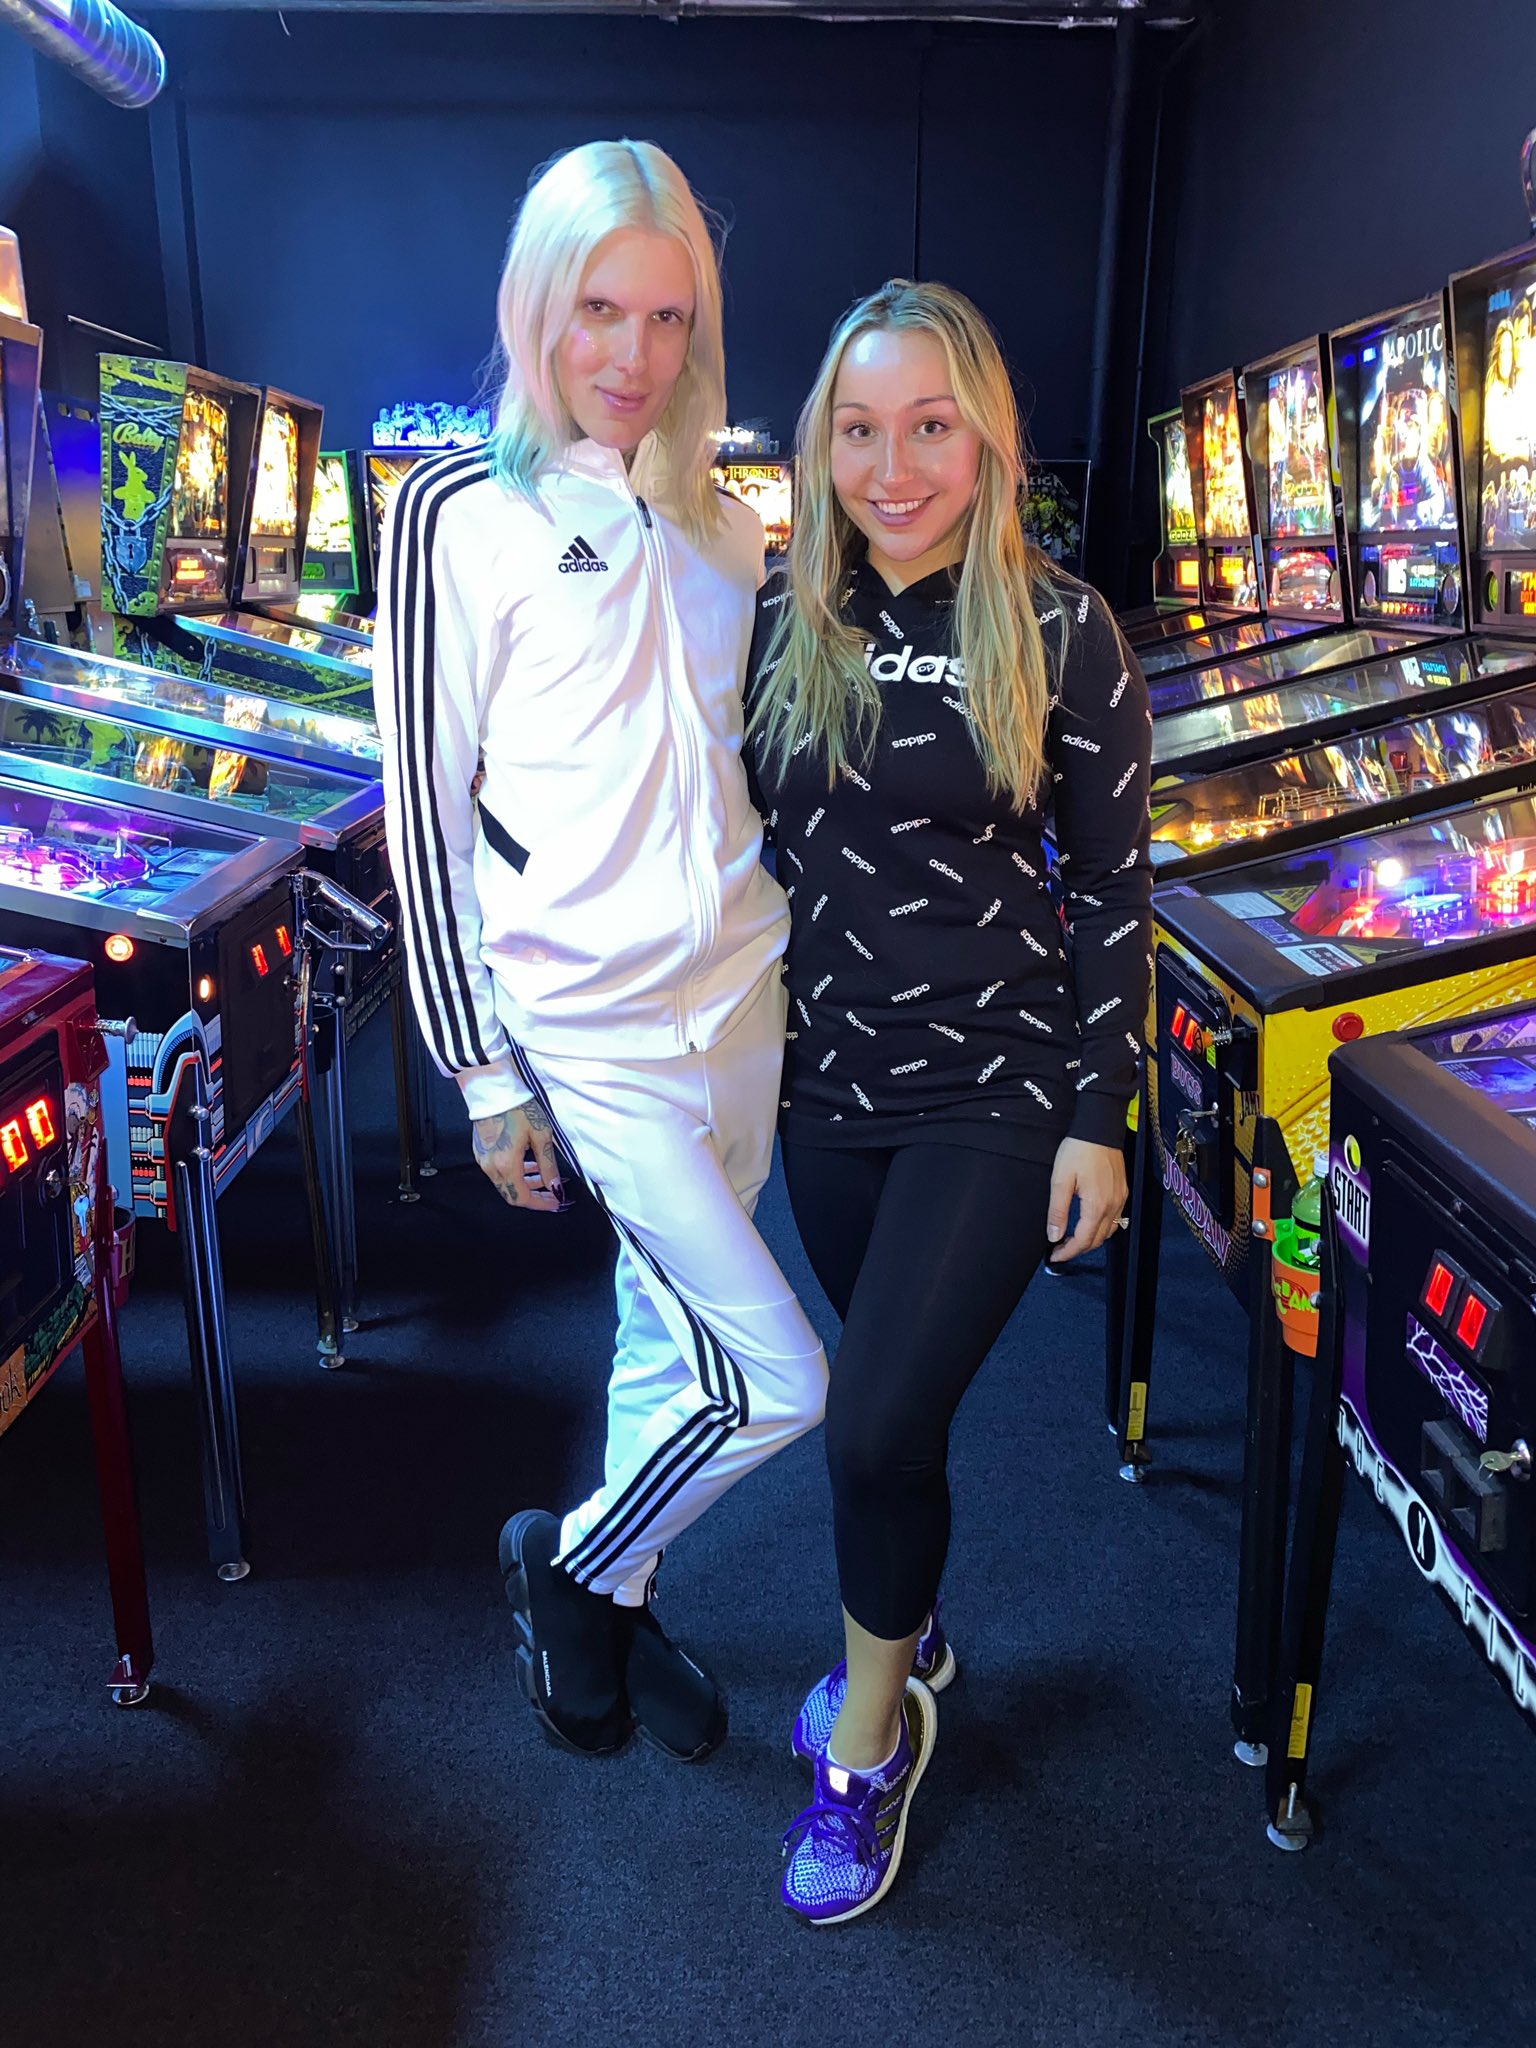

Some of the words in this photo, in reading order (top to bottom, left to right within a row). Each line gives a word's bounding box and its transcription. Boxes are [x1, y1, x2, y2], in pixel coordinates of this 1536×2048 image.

[727, 465, 780, 480] THRONES
[558, 558, 609, 574] adidas
[1078, 594, 1089, 623] adidas
[879, 610, 905, 639] adidas
[1110, 671, 1129, 707] adidas
[892, 732, 936, 749] adidas
[1062, 733, 1101, 753] adidas
[1113, 762, 1138, 797] adidas
[805, 808, 825, 837] adidas
[891, 817, 931, 834] adidas
[841, 847, 876, 874] adidas
[929, 859, 964, 883] adidas
[1012, 852, 1037, 877] adidas
[812, 894, 828, 921] adidas
[889, 899, 928, 917] adidas
[977, 899, 1002, 927] adidas
[845, 930, 873, 960] adidas
[1020, 929, 1048, 957] adidas
[1104, 920, 1139, 946] adidas
[811, 974, 833, 1000] adidas
[891, 983, 930, 1003] adidas
[977, 979, 1005, 1008] adidas
[846, 1011, 876, 1037] adidas
[1019, 1009, 1053, 1034] adidas
[1087, 996, 1122, 1025] adidas
[928, 1022, 965, 1043] adidas
[819, 1049, 837, 1072] adidas
[890, 1059, 928, 1076] adidas
[977, 1055, 1006, 1084] adidas
[1171, 1053, 1202, 1105] BUGS
[851, 1082, 874, 1112] adidas
[1024, 1080, 1053, 1110] adidas
[1163, 1148, 1231, 1266] JORDAN
[1334, 1166, 1369, 1240] START
[1416, 1508, 1427, 1561] X
[1464, 1581, 1526, 1702] FIL
